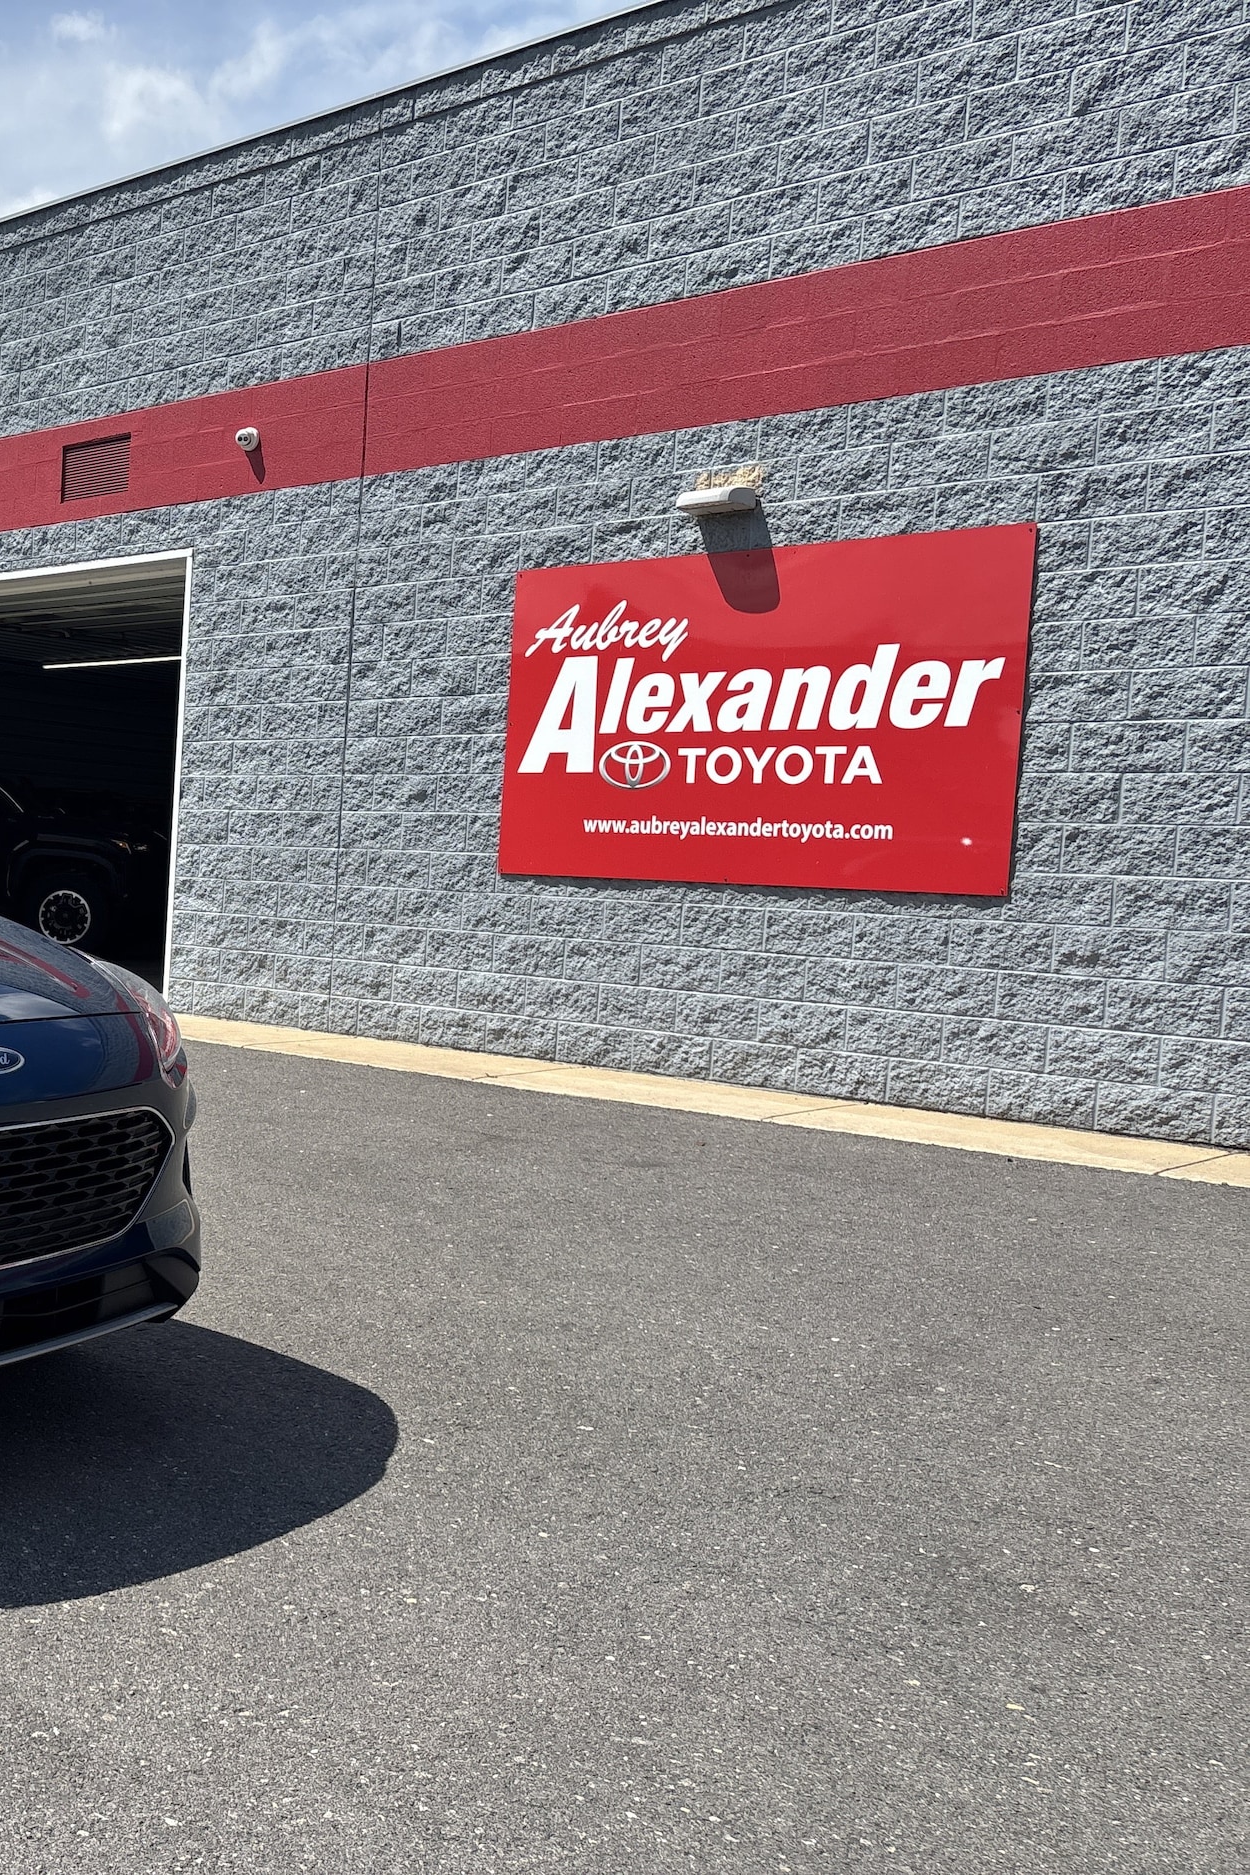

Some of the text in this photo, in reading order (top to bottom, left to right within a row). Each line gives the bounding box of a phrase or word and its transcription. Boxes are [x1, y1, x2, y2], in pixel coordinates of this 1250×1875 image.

[525, 600, 688, 662] Aubrey
[517, 643, 1006, 774] Alexander
[678, 746, 883, 785] TOYOTA
[583, 815, 894, 843] www.aubreyalexandertoyota.com
